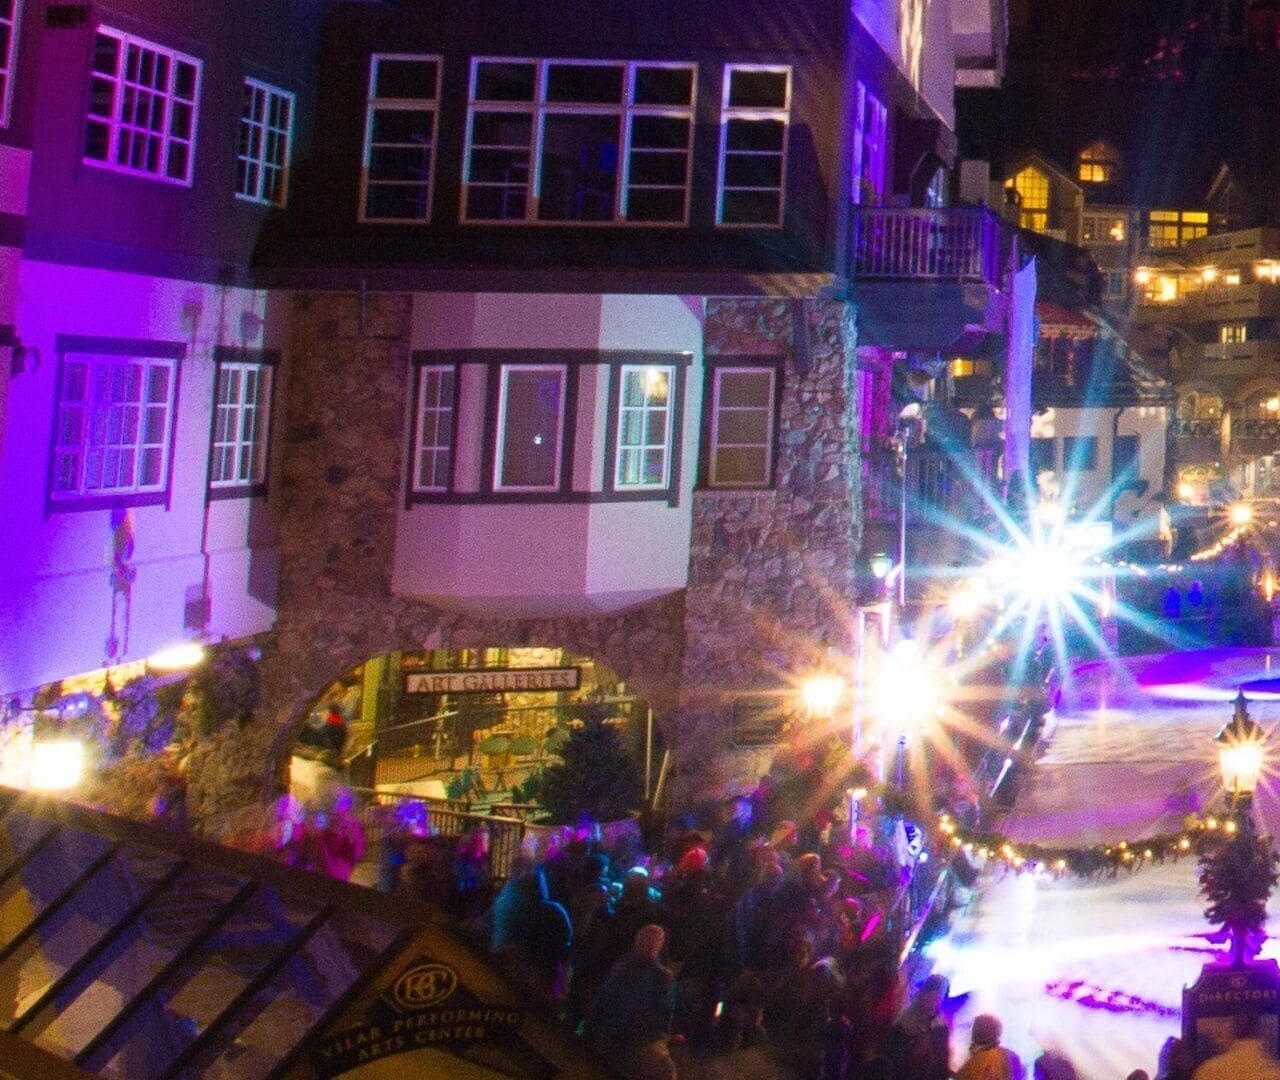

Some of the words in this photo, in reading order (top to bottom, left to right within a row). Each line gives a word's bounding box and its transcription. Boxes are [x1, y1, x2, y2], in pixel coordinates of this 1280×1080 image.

[416, 675, 455, 692] ART
[463, 671, 570, 691] GALLERIES
[393, 1008, 519, 1033] PERFORMING
[358, 1034, 405, 1061] ARTS
[415, 1024, 486, 1044] CENTER
